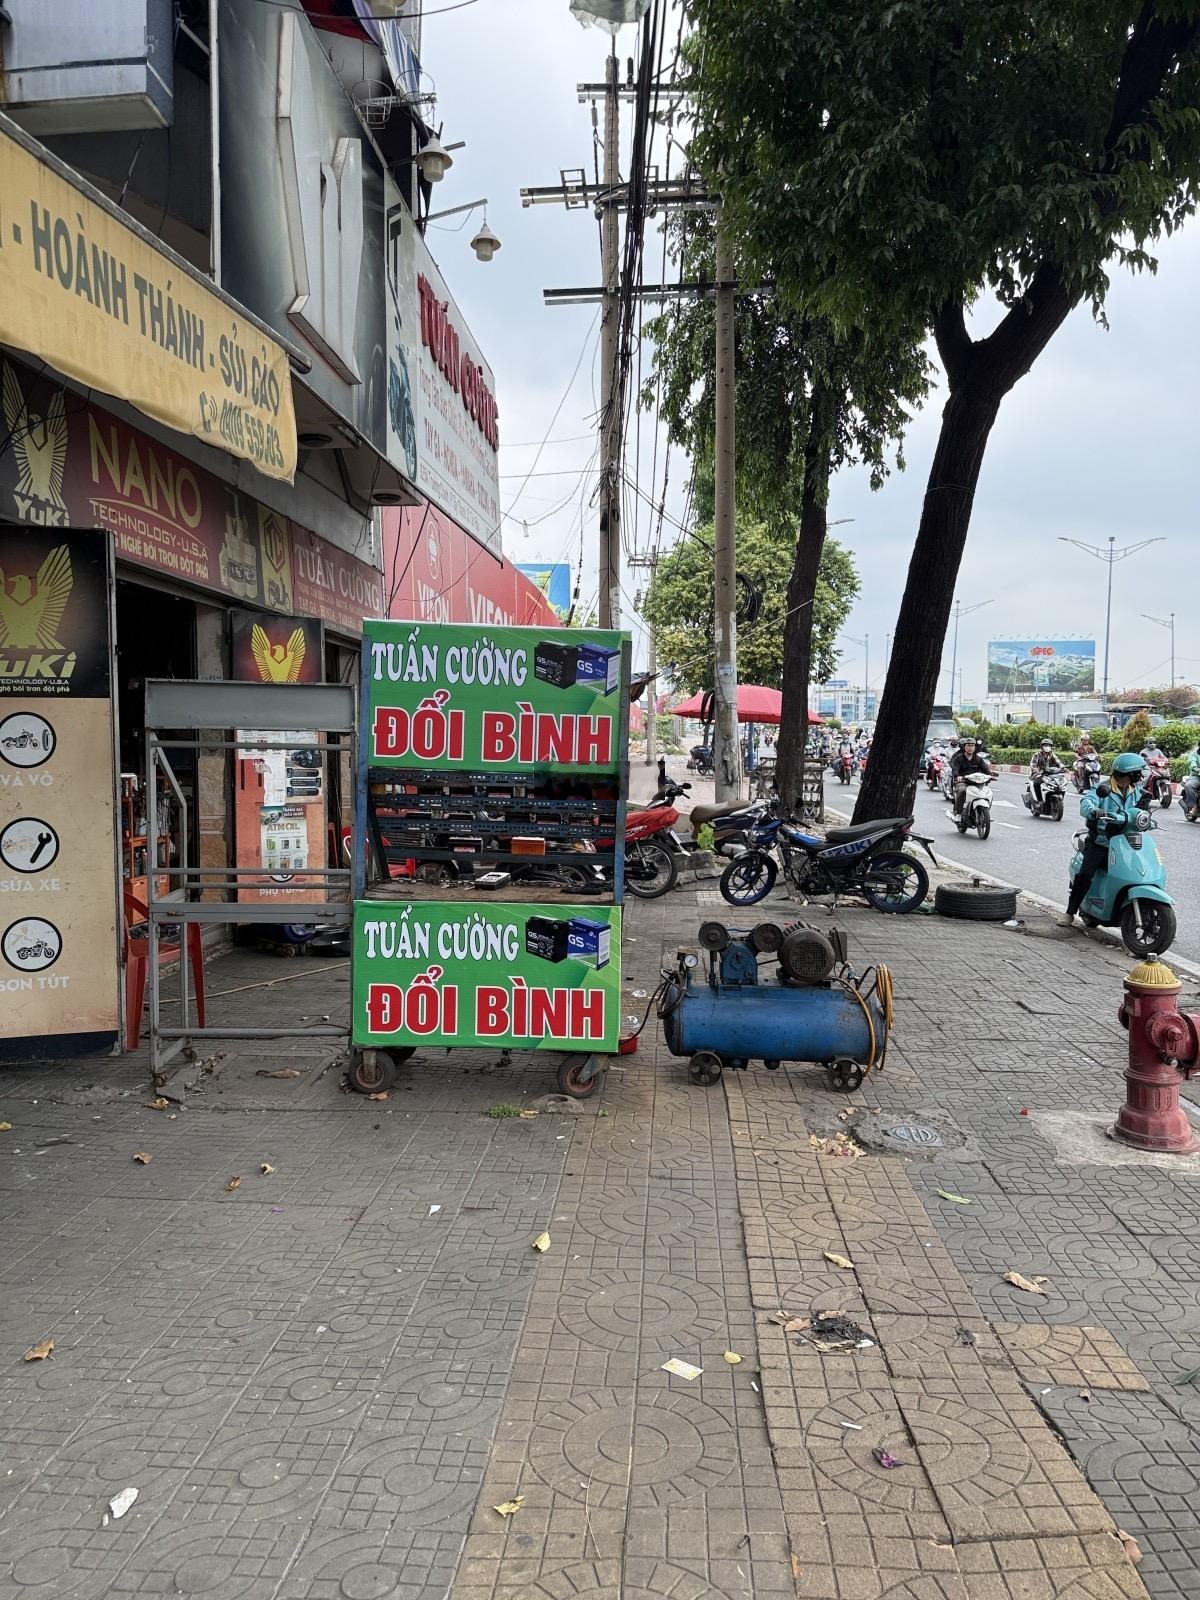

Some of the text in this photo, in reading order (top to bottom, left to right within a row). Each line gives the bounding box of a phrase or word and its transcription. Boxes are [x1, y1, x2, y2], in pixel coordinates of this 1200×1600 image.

[31, 200, 129, 325] HOÀNH
[134, 273, 205, 373] THÁNH
[220, 322, 248, 397] SỦI
[252, 345, 280, 417] CẢO
[88, 413, 202, 528] NANO
[0, 651, 77, 678] uKi
[371, 626, 528, 687] TUẤN CƯỜNG
[577, 660, 593, 674] GS
[372, 689, 613, 765] ĐỔI BÌNH
[39, 878, 61, 892] XE
[363, 904, 519, 962] TUẤN CƯỜNG
[568, 934, 585, 948] GS
[38, 973, 70, 989] TÚT
[366, 965, 605, 1040] ĐỔI BÌNH
